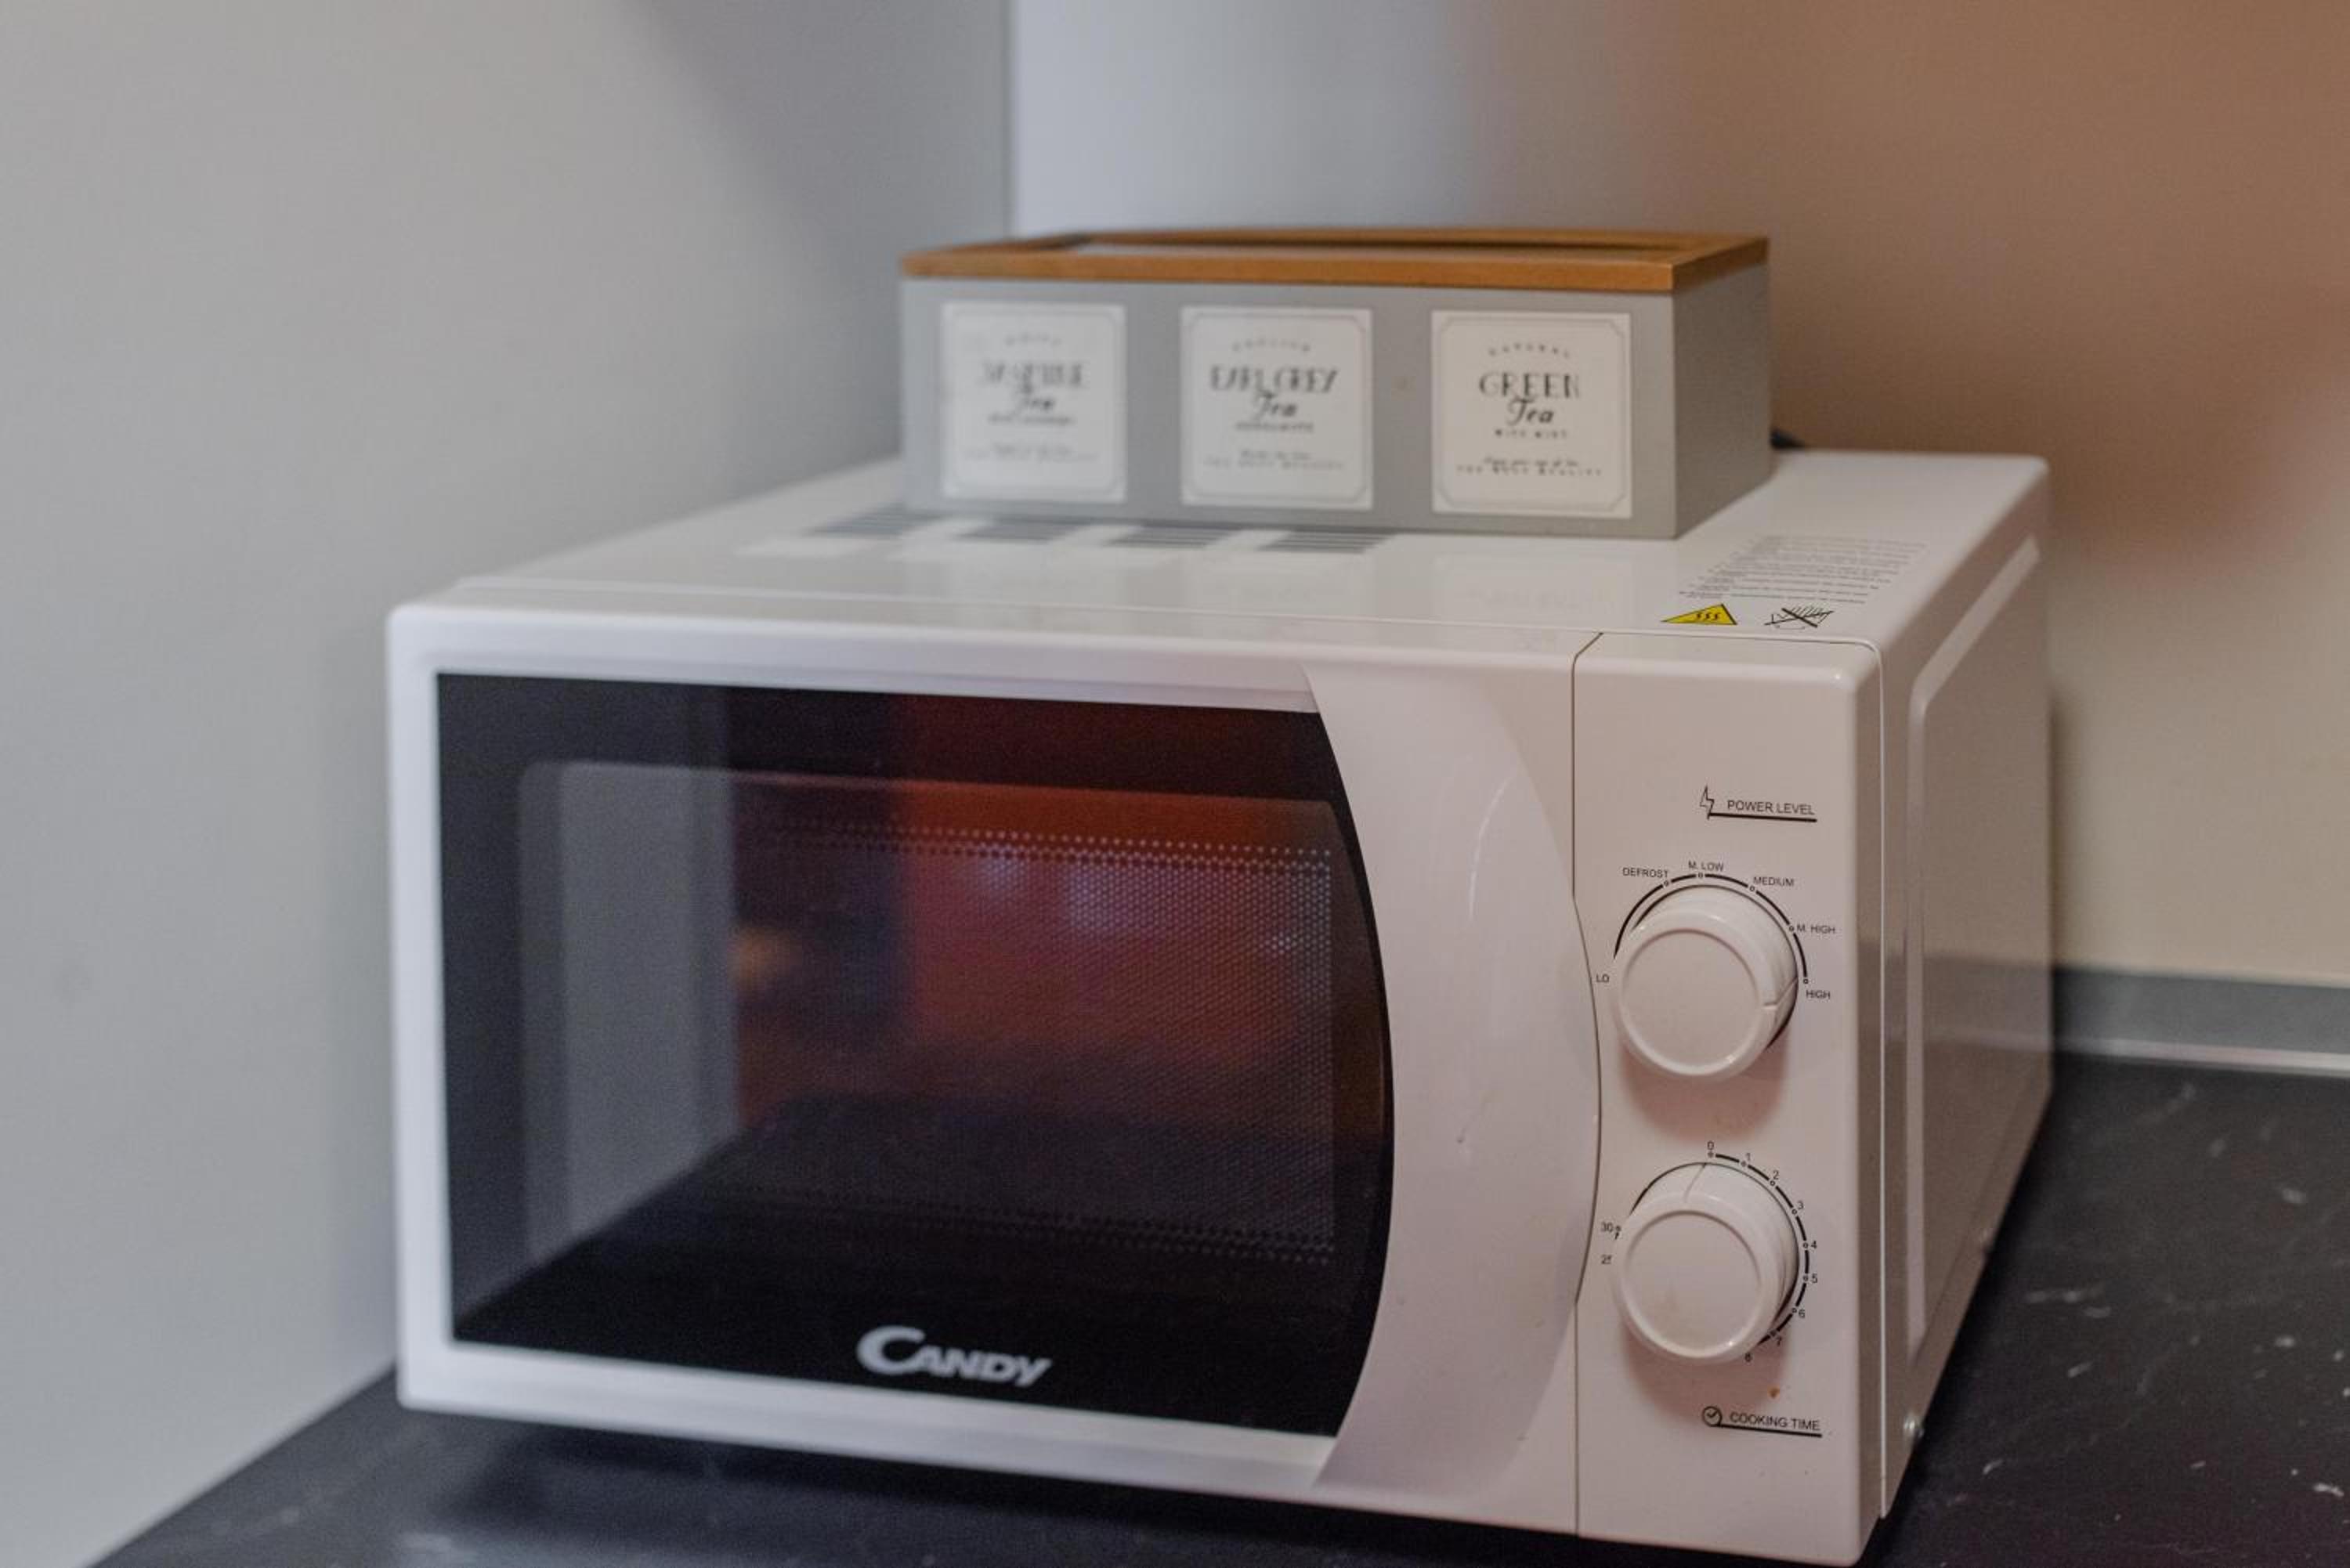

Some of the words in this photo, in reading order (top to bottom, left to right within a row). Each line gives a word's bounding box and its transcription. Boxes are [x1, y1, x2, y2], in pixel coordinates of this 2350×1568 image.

[1478, 372, 1580, 399] GREEN
[1252, 390, 1298, 421] Tea
[1506, 395, 1555, 427] Tea
[1727, 799, 1774, 814] POWER
[1776, 802, 1816, 816] LEVEL
[1622, 867, 1668, 879] DEFROST
[1701, 862, 1724, 873] LOW
[1753, 876, 1795, 887] MEDIUM
[1810, 924, 1836, 935] HIGH
[1806, 989, 1831, 1000] HIGH
[1707, 1140, 1715, 1151] 0
[1745, 1152, 1752, 1162] 1
[1773, 1169, 1780, 1180] 2
[1797, 1200, 1805, 1211] 3
[1600, 1220, 1614, 1233] 30
[1810, 1240, 1817, 1250] 4
[1811, 1273, 1818, 1284] 5
[1798, 1308, 1806, 1319] 6
[856, 1324, 1052, 1387] CANDY
[1729, 1411, 1788, 1428] COOKING
[1791, 1417, 1821, 1431] TIME
